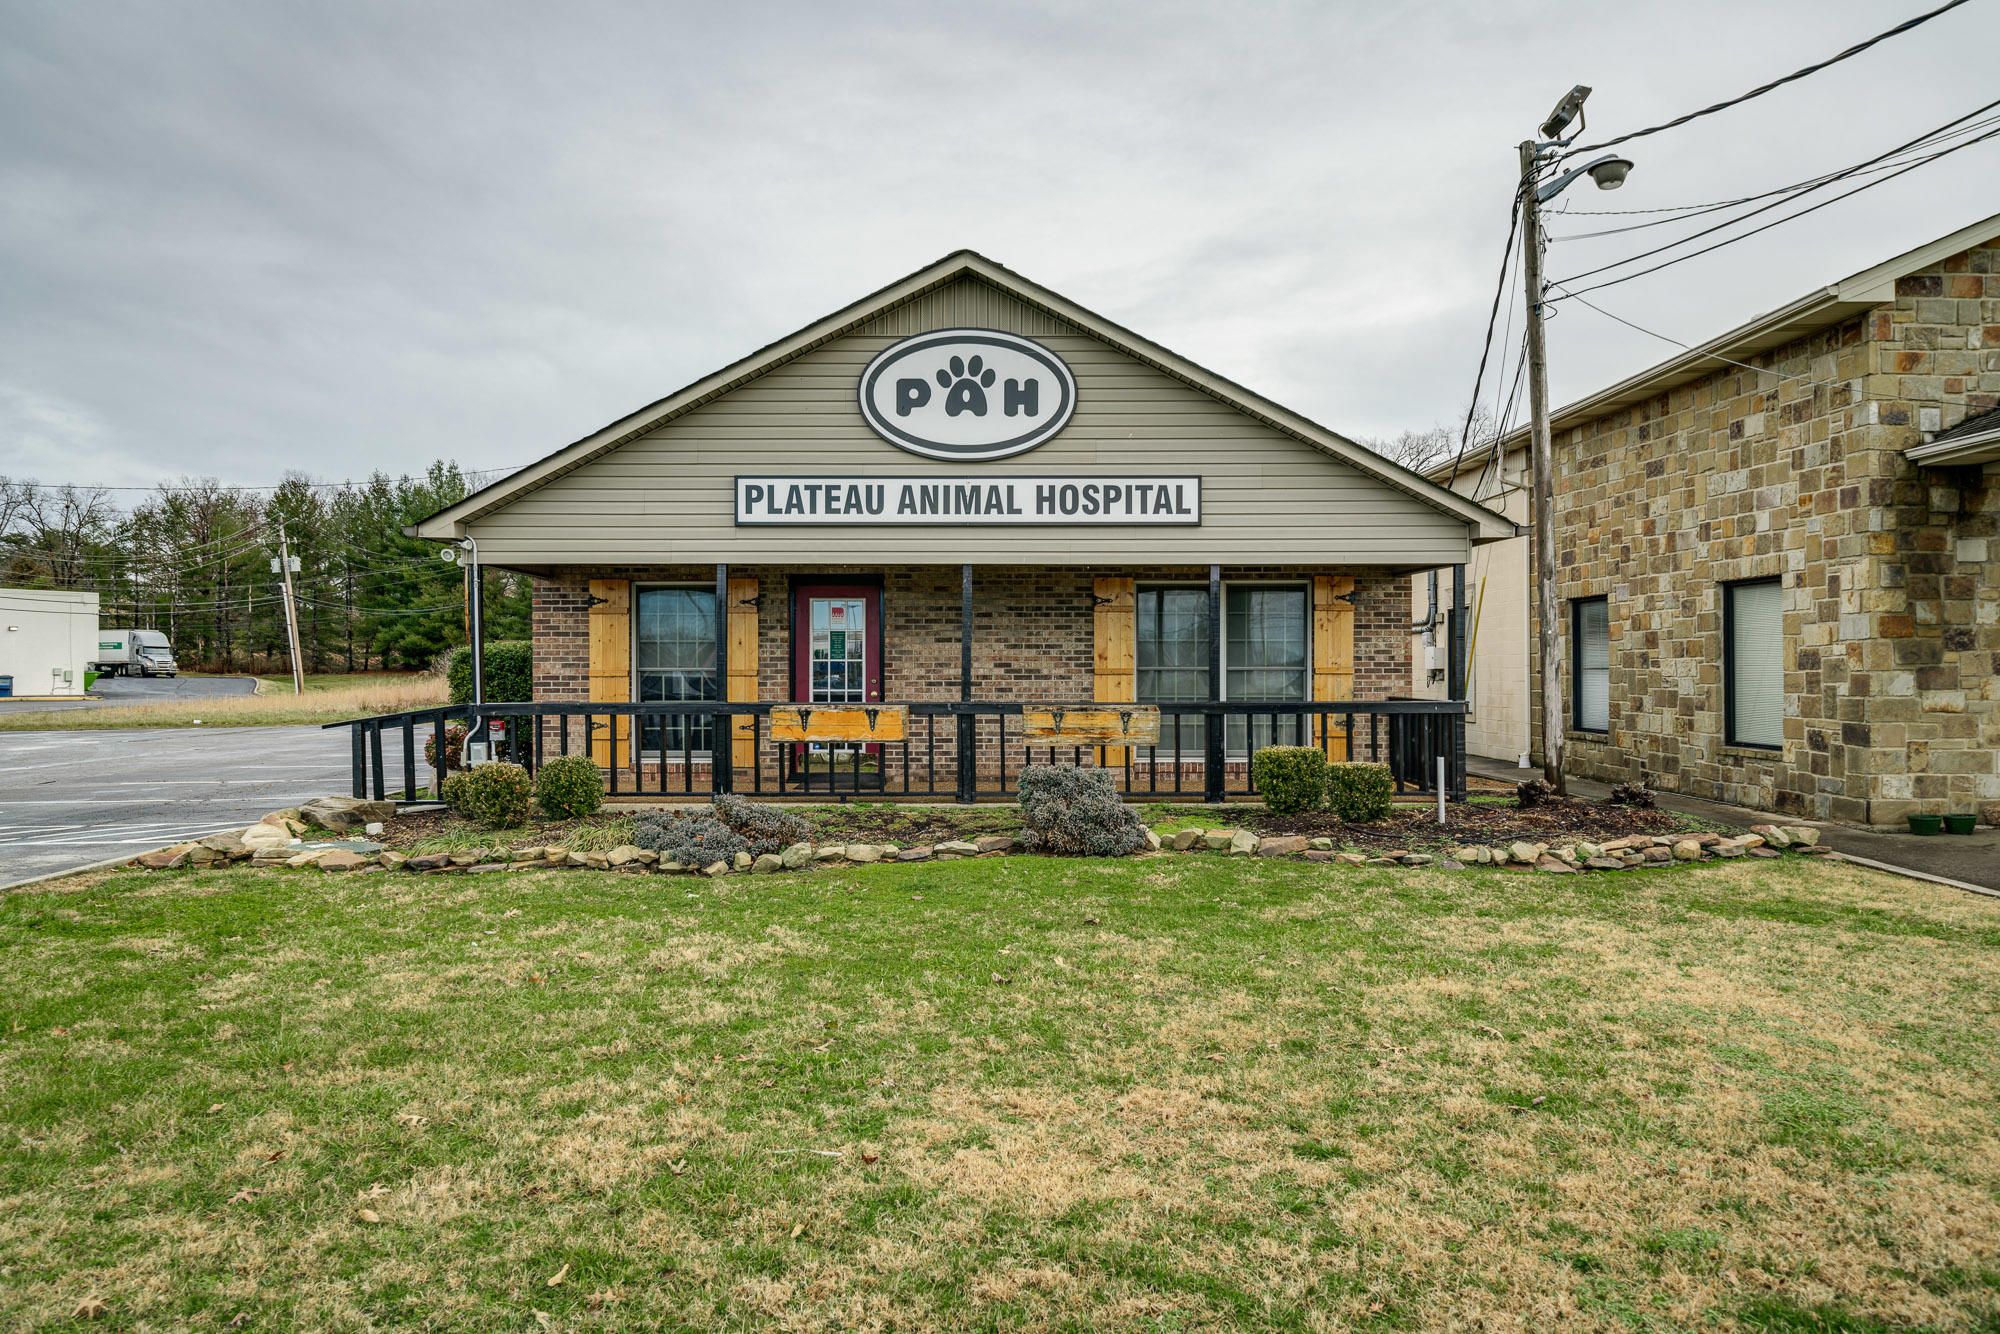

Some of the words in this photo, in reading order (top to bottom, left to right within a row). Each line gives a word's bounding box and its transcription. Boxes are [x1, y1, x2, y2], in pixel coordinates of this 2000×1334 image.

[896, 378, 1038, 417] PAH
[745, 484, 884, 515] PLATEAU
[897, 484, 1022, 515] ANIMAL
[1036, 484, 1191, 515] HOSPITAL
